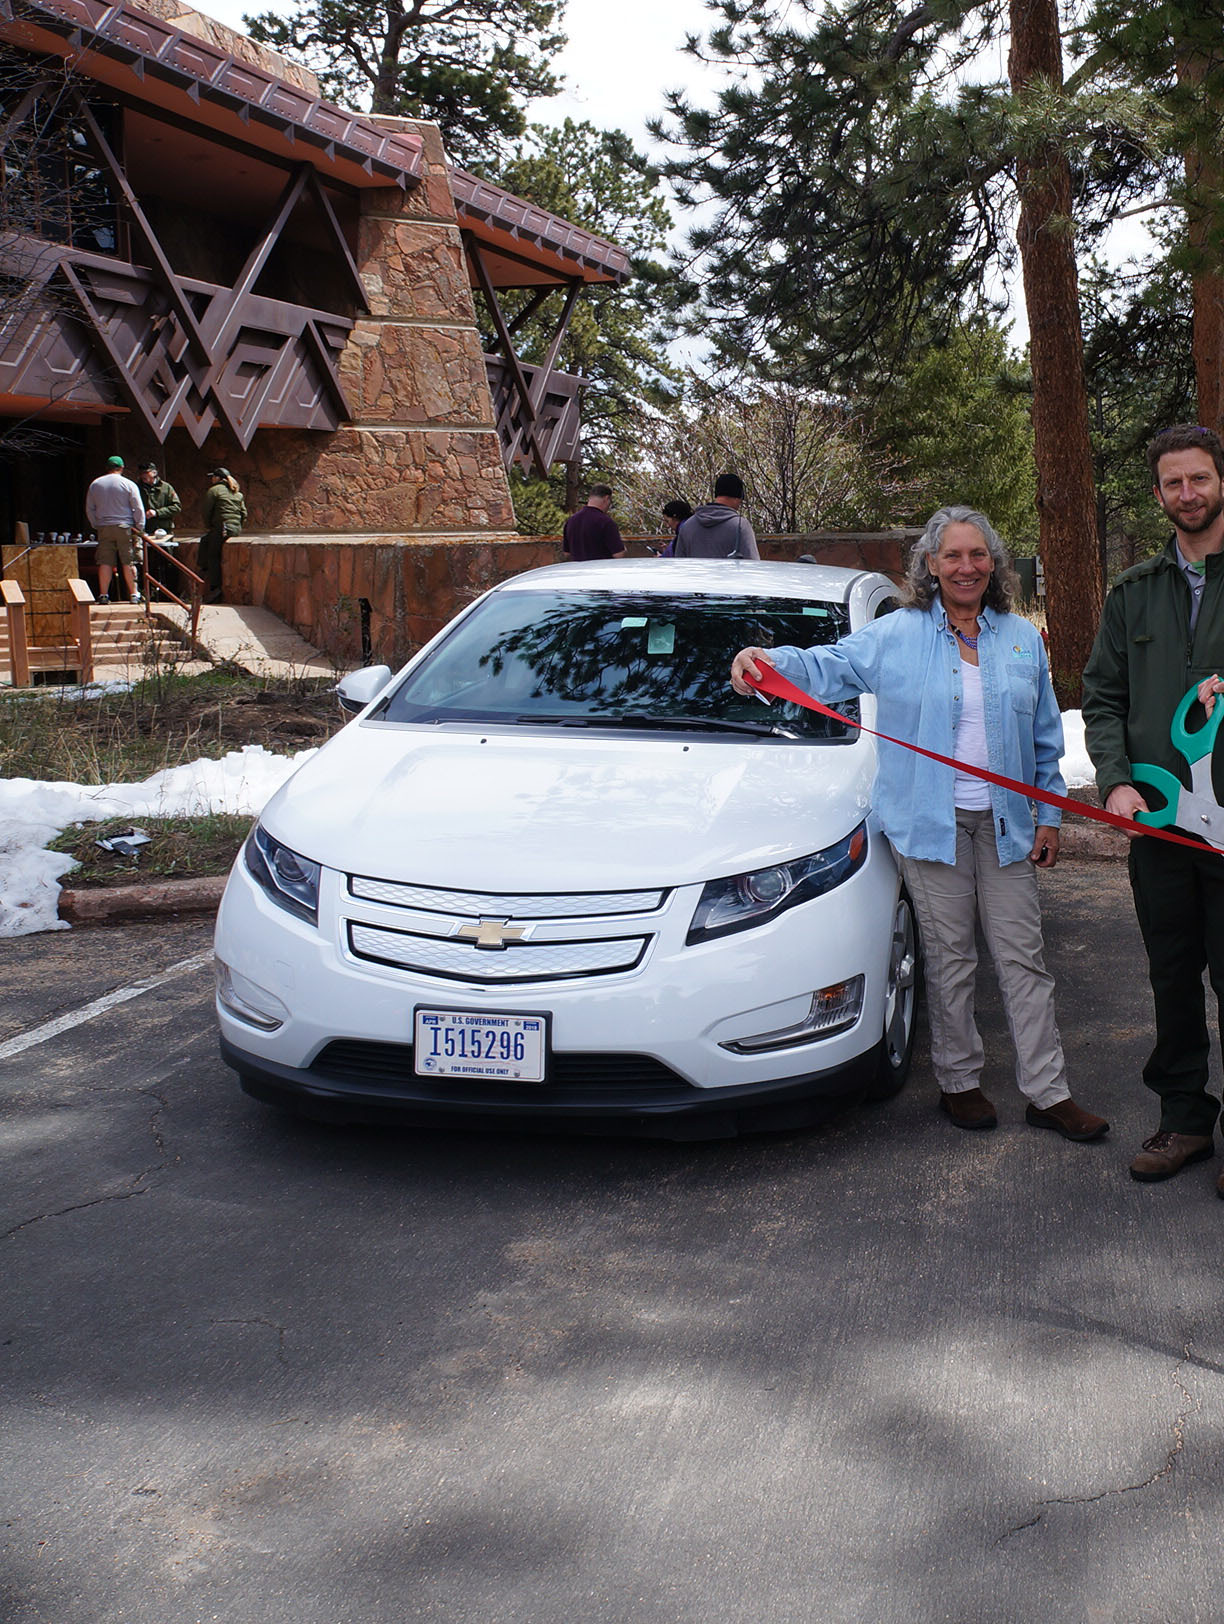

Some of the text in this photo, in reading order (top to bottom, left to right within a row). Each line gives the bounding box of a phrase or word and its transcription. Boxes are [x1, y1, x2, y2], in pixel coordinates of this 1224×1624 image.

[451, 1016, 509, 1027] U.S. GOVERNMENT
[429, 1026, 525, 1061] I515296
[462, 1066, 484, 1074] OFFICIAL
[485, 1067, 495, 1075] USE
